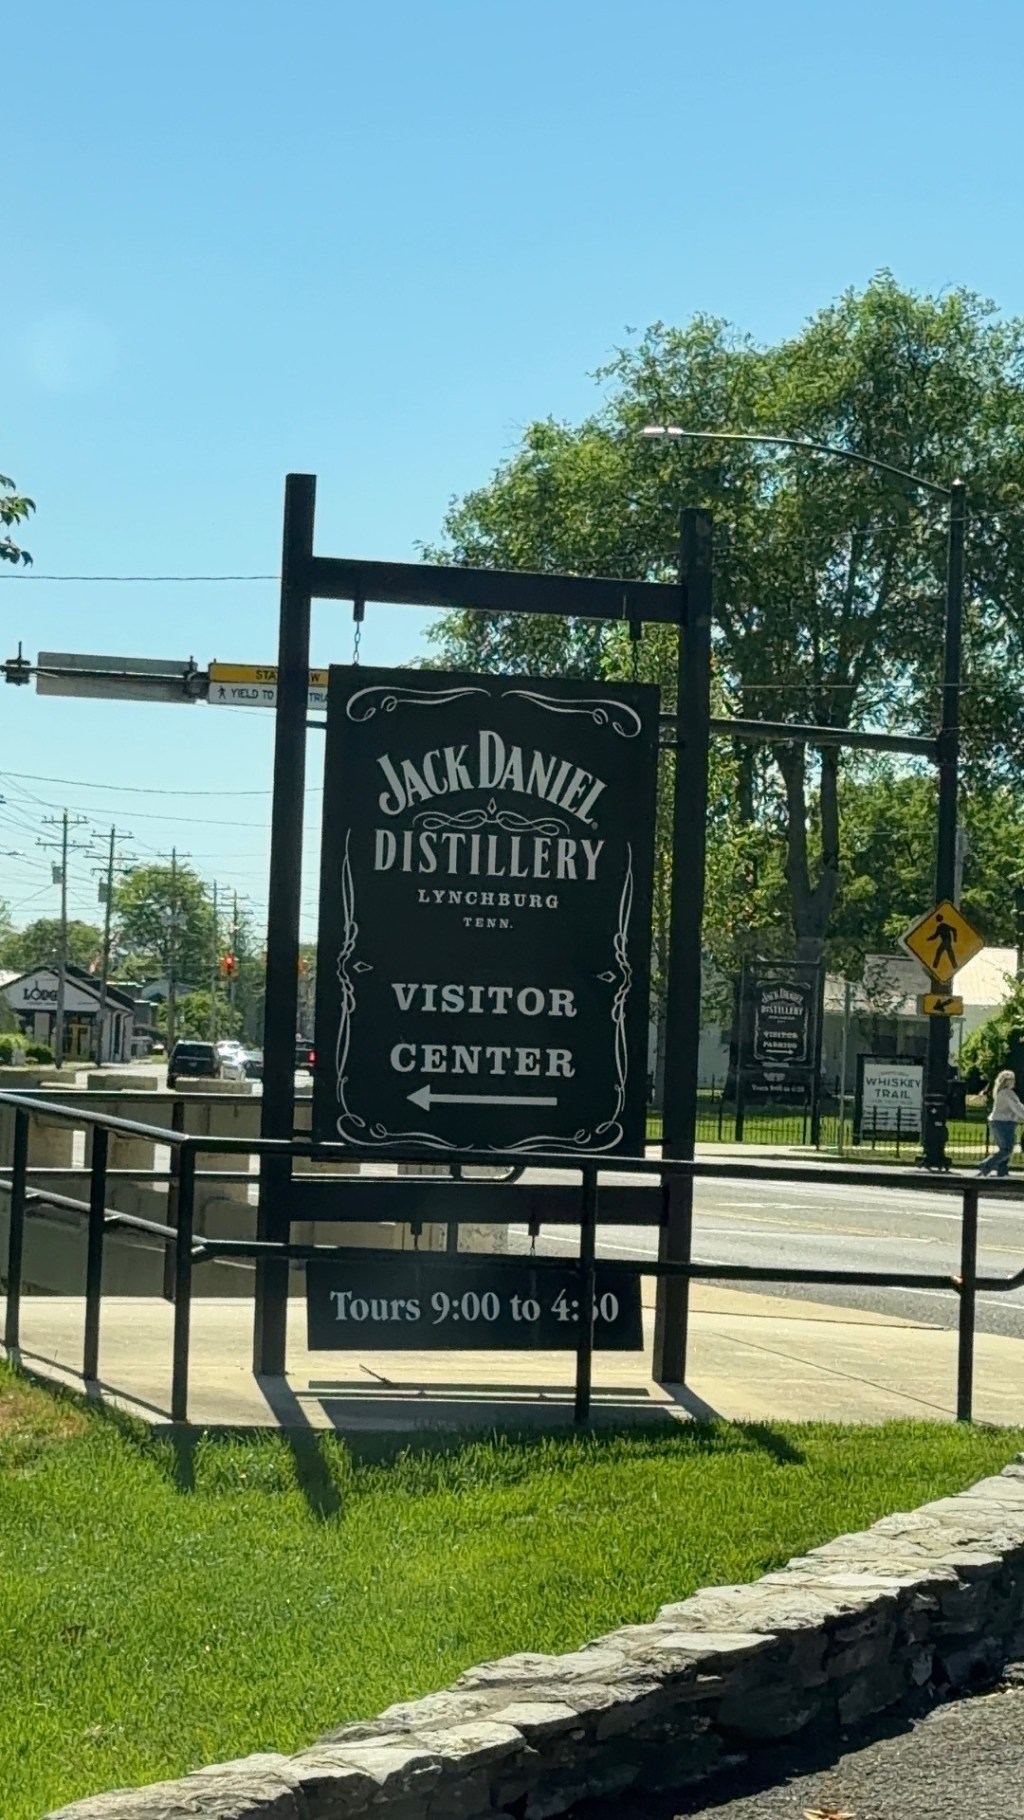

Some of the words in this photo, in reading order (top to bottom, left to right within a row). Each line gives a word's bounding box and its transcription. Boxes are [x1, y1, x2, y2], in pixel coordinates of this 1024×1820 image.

[231, 688, 259, 699] YIELD
[262, 689, 275, 700] TO
[376, 744, 474, 816] JACK
[478, 730, 608, 825] DANIEL
[373, 828, 605, 880] DISTILLERY
[418, 889, 560, 909] LYNCHBURG
[463, 917, 514, 929] TENN.
[391, 983, 578, 1018] VISITOR
[390, 1043, 576, 1078] CENTER
[866, 1077, 921, 1089] WHISKEY
[874, 1088, 911, 1099] TRAIL
[330, 1290, 421, 1322] Tours
[431, 1291, 501, 1325] 9:00
[510, 1294, 541, 1322] to
